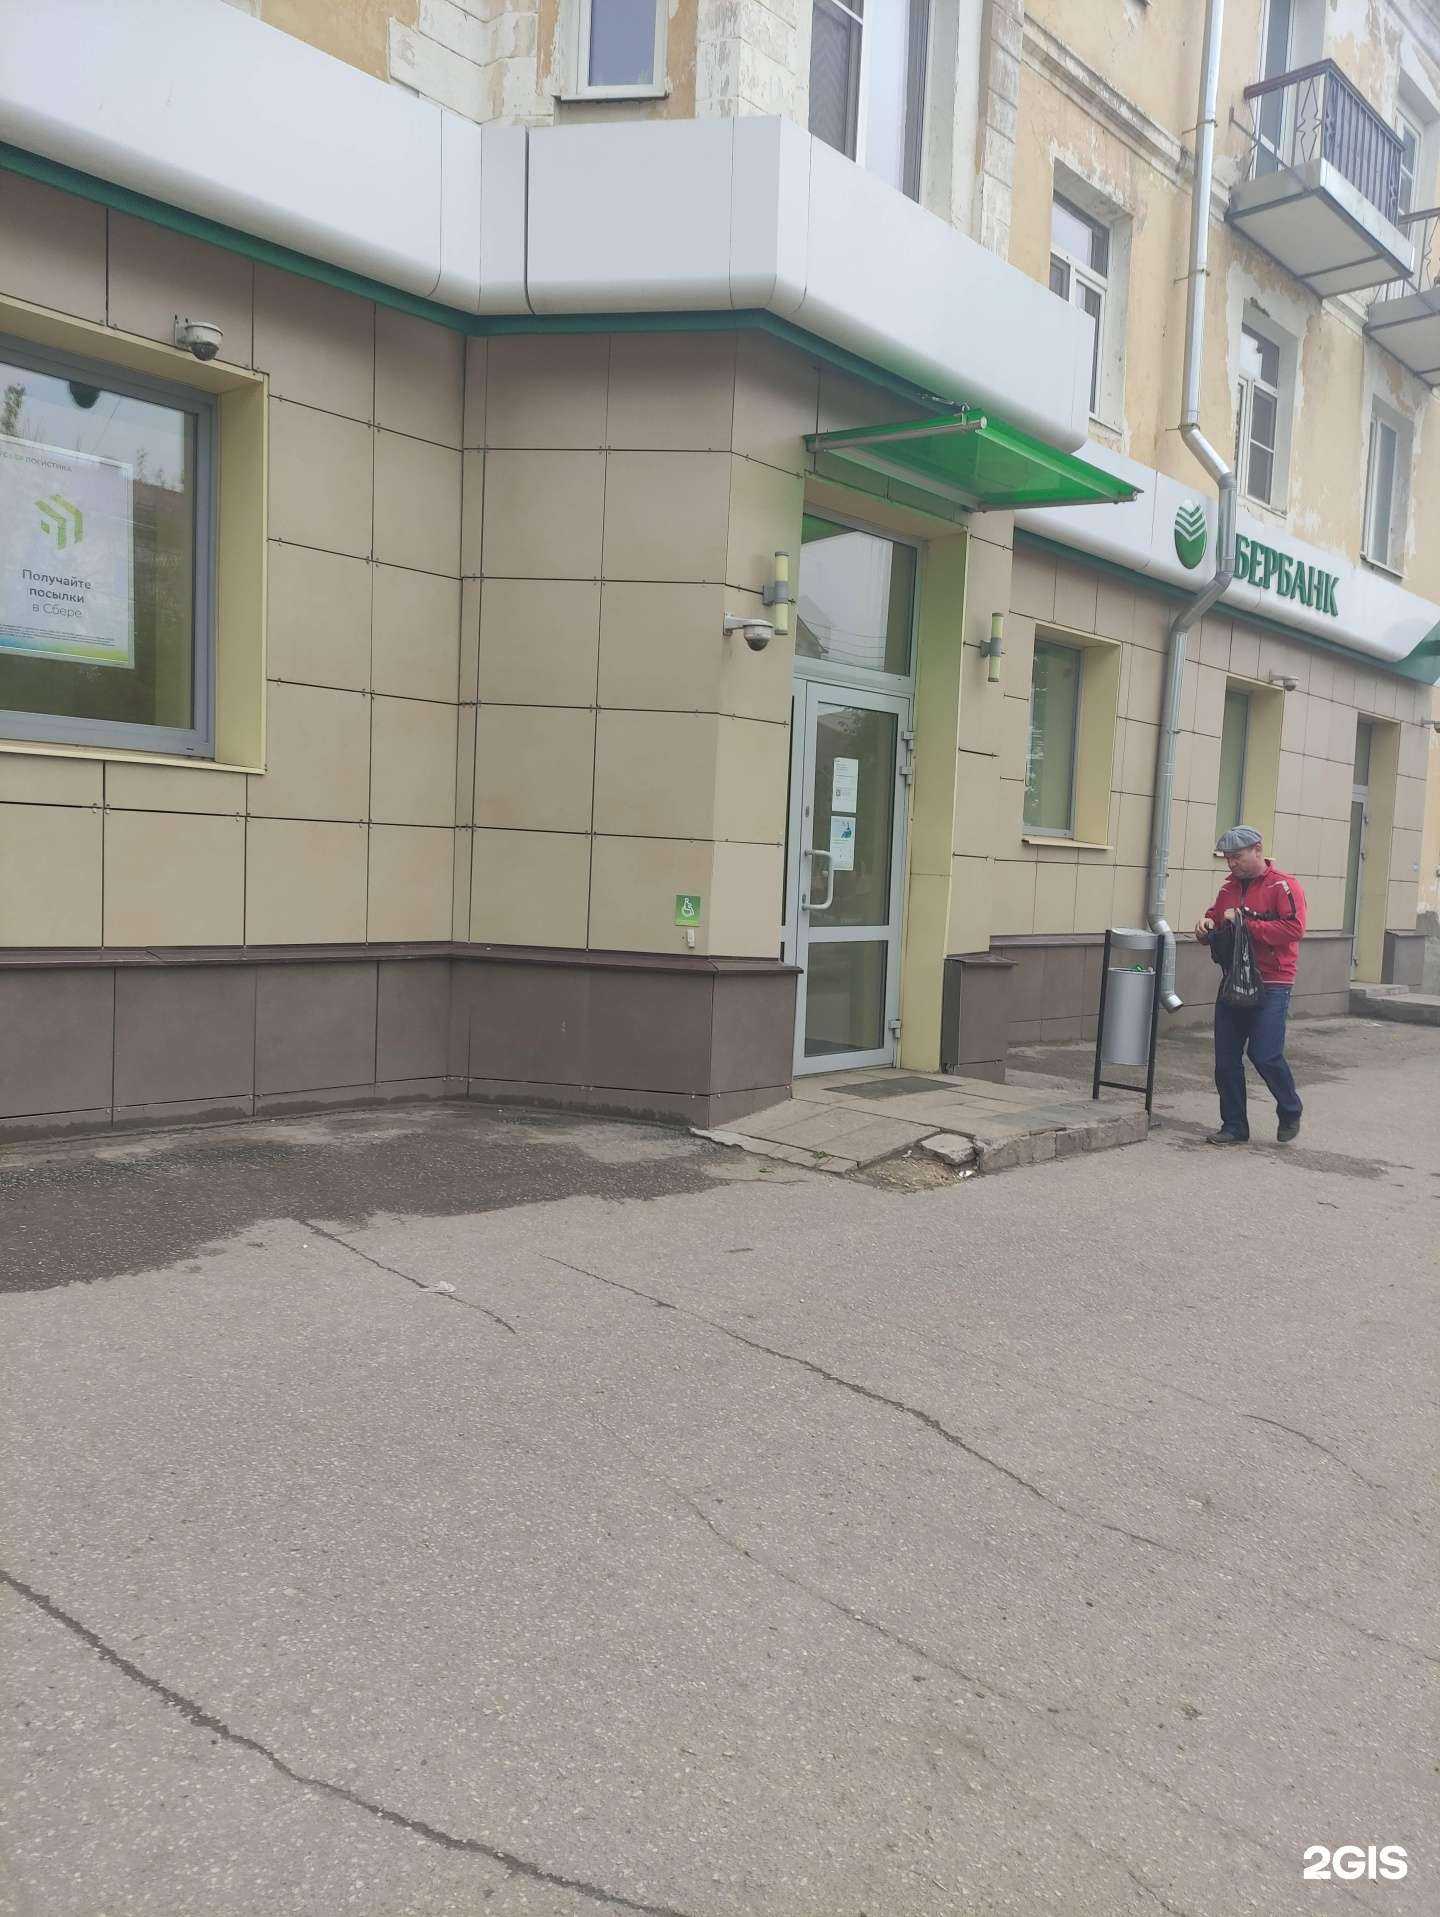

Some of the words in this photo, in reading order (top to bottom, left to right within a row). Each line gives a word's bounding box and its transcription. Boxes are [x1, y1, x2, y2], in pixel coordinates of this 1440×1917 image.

[22, 568, 92, 590] Получайте
[1233, 533, 1339, 617] БЕРБАНК
[29, 588, 85, 604] посылки
[32, 603, 40, 612] в
[42, 602, 83, 617] Сбере
